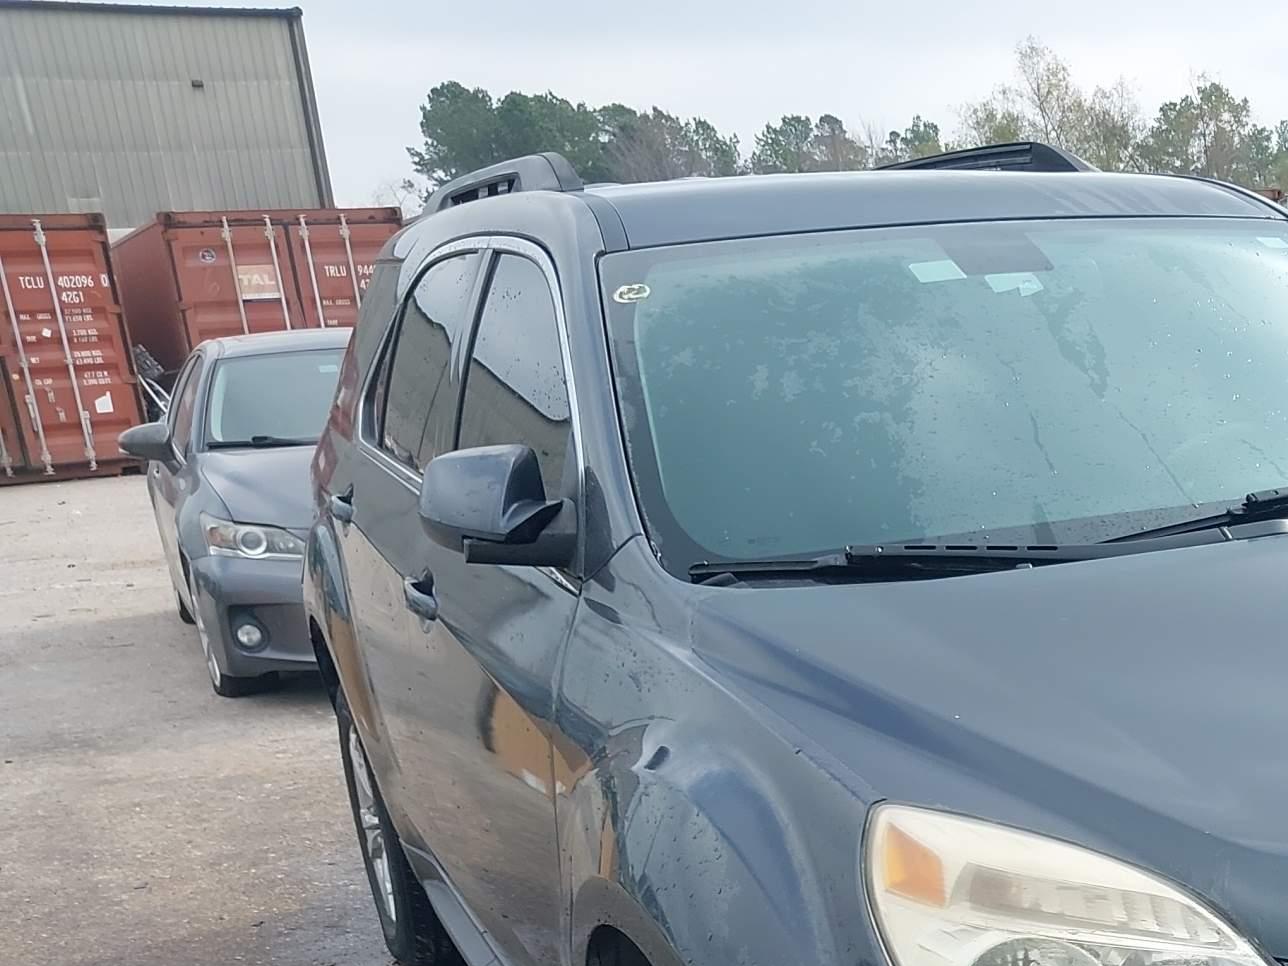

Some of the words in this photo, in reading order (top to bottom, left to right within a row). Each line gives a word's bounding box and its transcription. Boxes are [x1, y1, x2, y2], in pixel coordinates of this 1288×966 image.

[324, 264, 347, 277] TRLU
[357, 264, 376, 276] 944
[18, 276, 45, 289] TCLU
[57, 275, 94, 288] 402096
[238, 273, 276, 286] TAL
